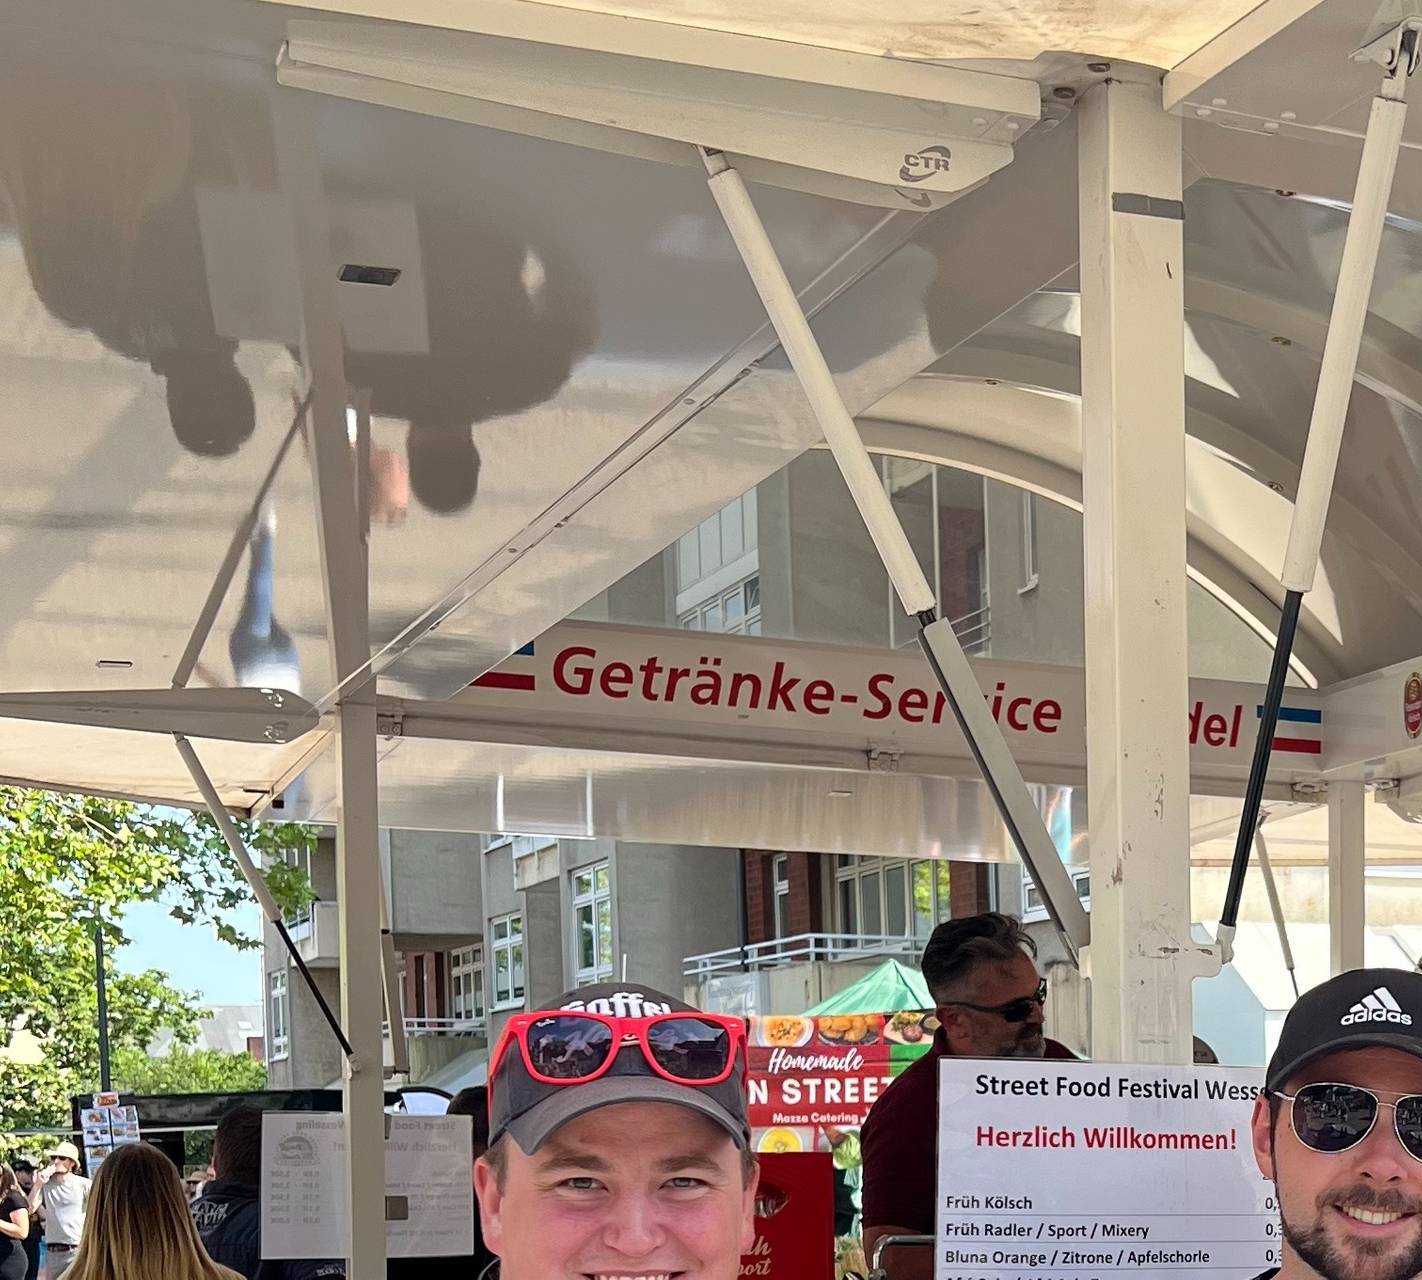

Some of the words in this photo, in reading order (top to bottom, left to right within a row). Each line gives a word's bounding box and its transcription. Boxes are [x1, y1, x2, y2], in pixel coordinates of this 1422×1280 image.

[904, 154, 949, 171] CTR
[552, 645, 1062, 734] Getränke-Serice
[1189, 701, 1243, 747] del
[1341, 1007, 1413, 1026] adidas
[768, 1047, 864, 1074] Homemade
[976, 1074, 1048, 1096] Street
[1056, 1077, 1110, 1098] Food
[1118, 1078, 1199, 1100] Festival
[811, 1112, 859, 1124] Catering
[976, 1125, 1075, 1148] Herzlich
[1084, 1128, 1237, 1150] Willkommen!
[946, 1195, 979, 1210] Früh
[985, 1195, 1032, 1210] Kölsch
[945, 1222, 979, 1237] Früh
[984, 1223, 1033, 1237] Radler
[1048, 1224, 1087, 1240] Sport
[1101, 1224, 1150, 1240] Mixery
[945, 1250, 988, 1264] Bluna
[992, 1251, 1047, 1267] Orange
[1062, 1250, 1113, 1265] Zitrone
[1127, 1249, 1210, 1266] Apfelschorle
